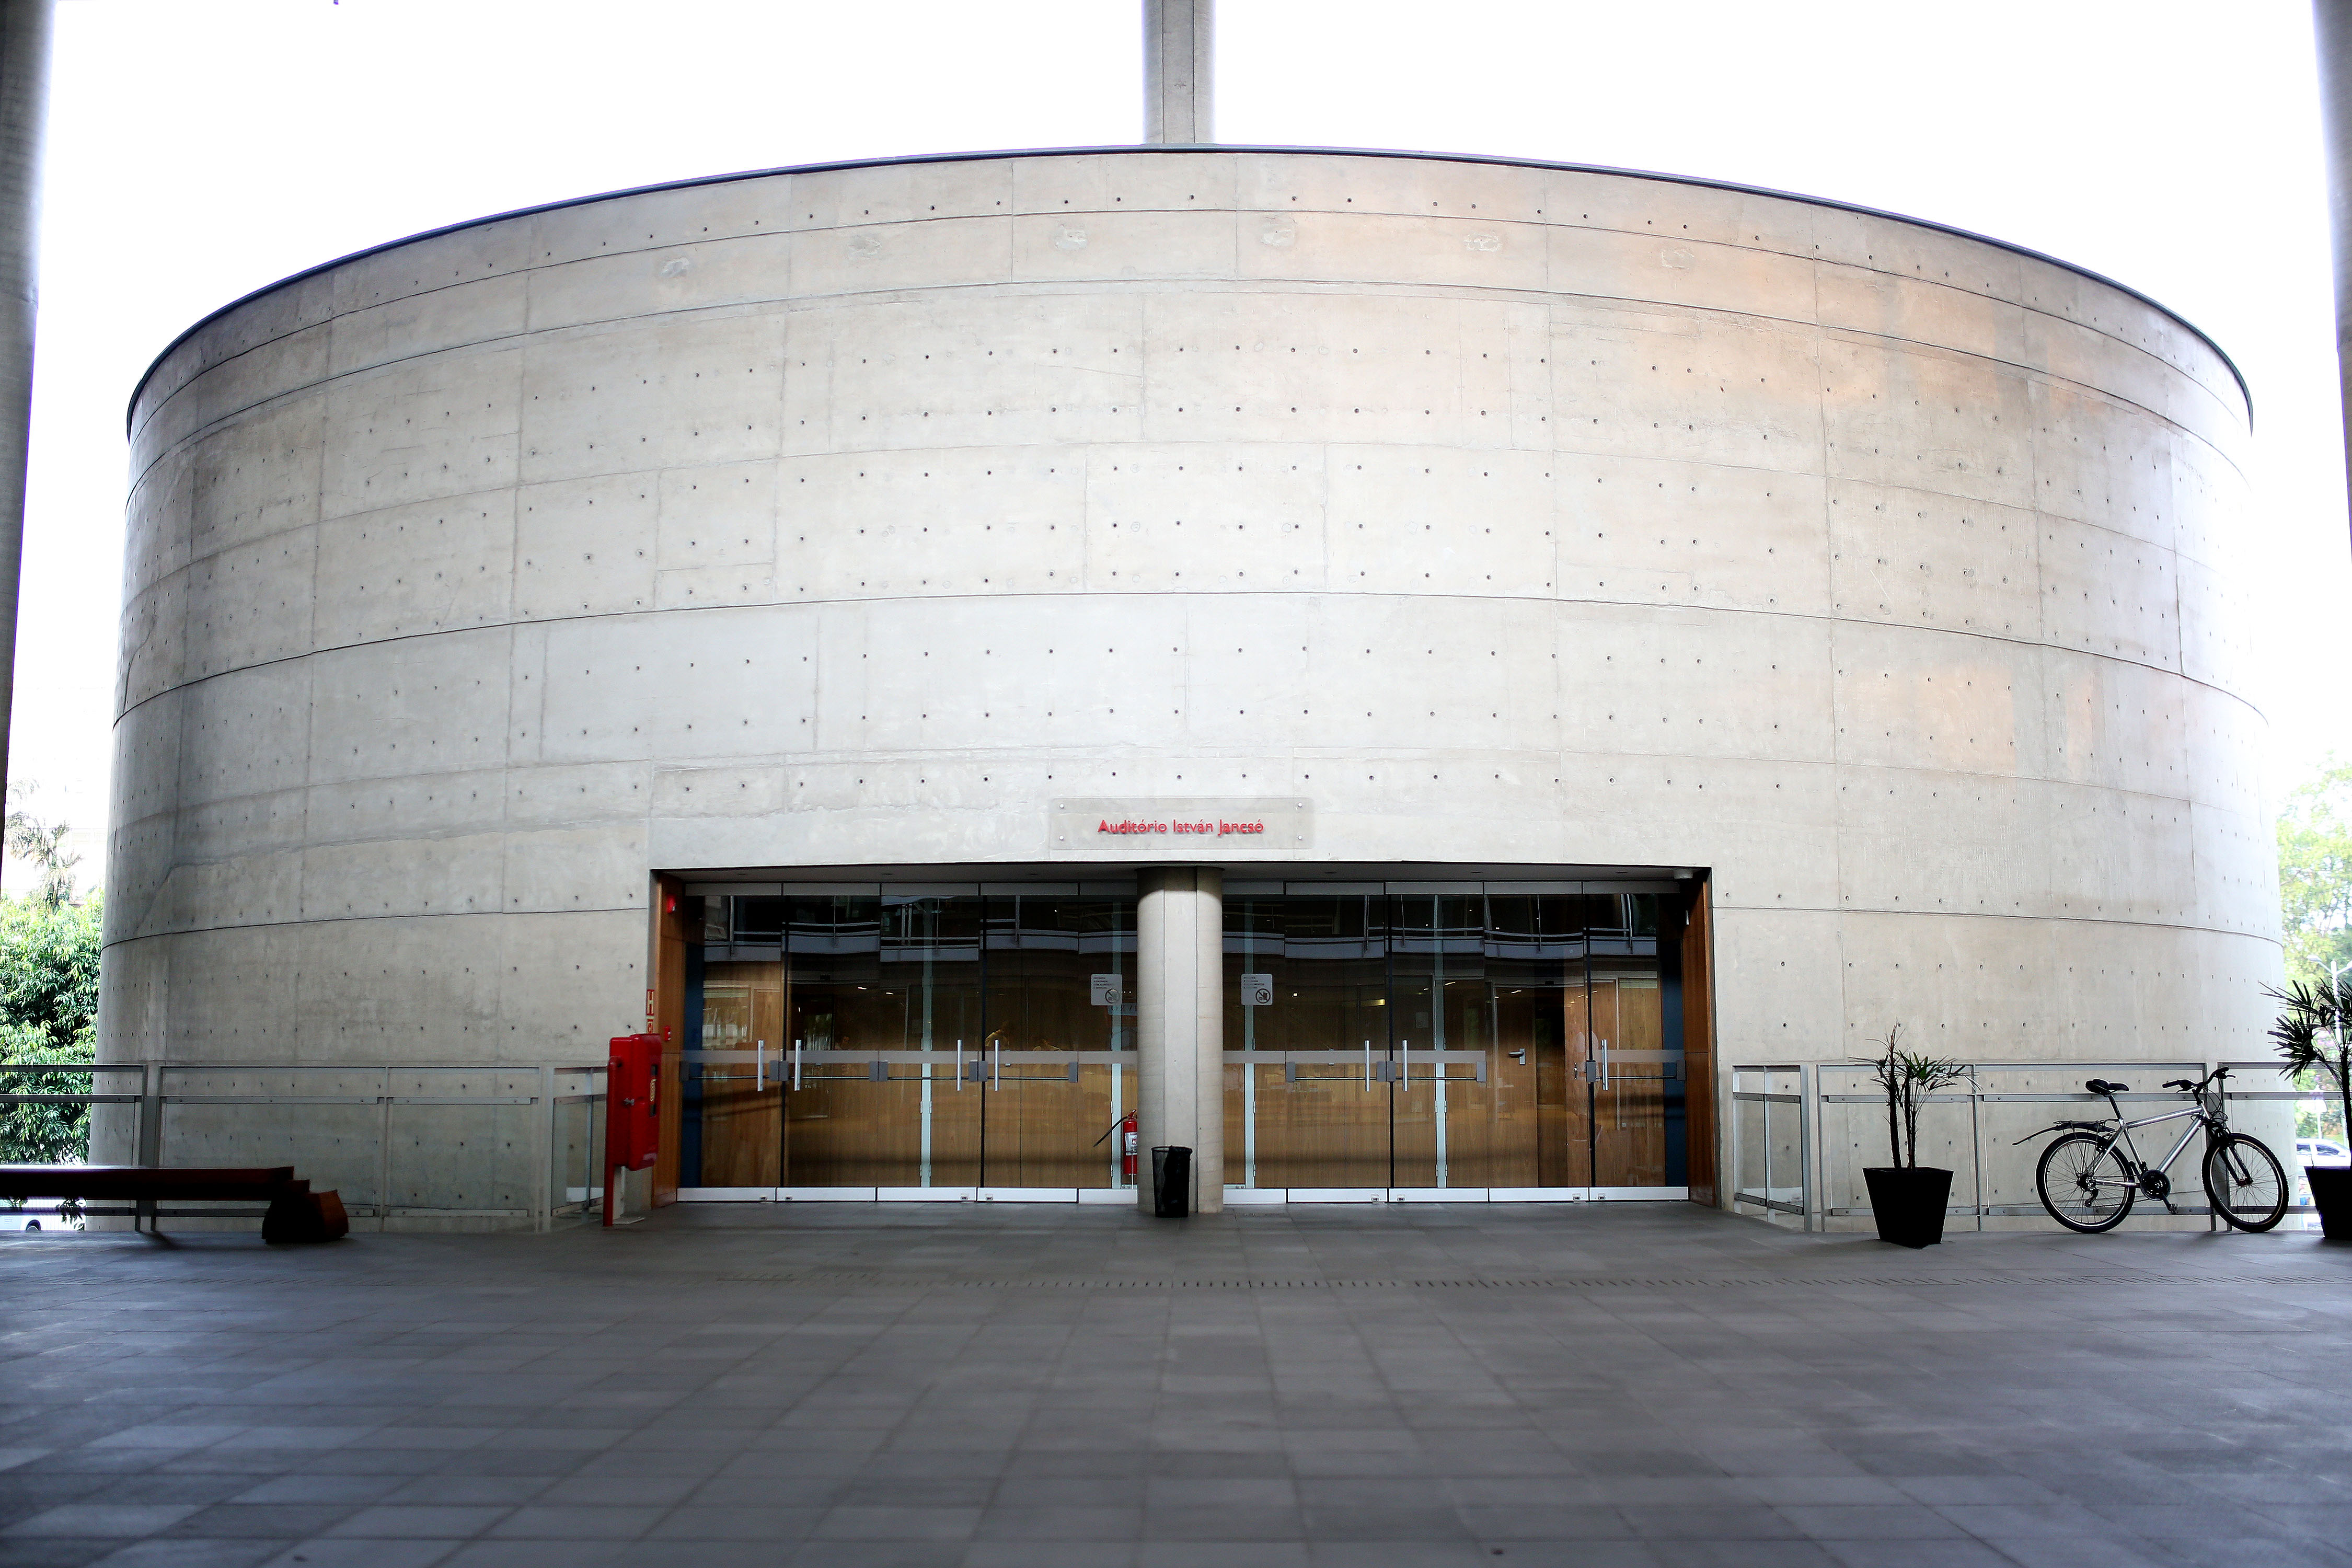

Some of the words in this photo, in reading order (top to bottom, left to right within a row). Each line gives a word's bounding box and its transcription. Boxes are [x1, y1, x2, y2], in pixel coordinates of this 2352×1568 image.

[1097, 819, 1167, 834] Auditório
[1173, 819, 1213, 833] István
[1217, 819, 1264, 836] Jancsó
